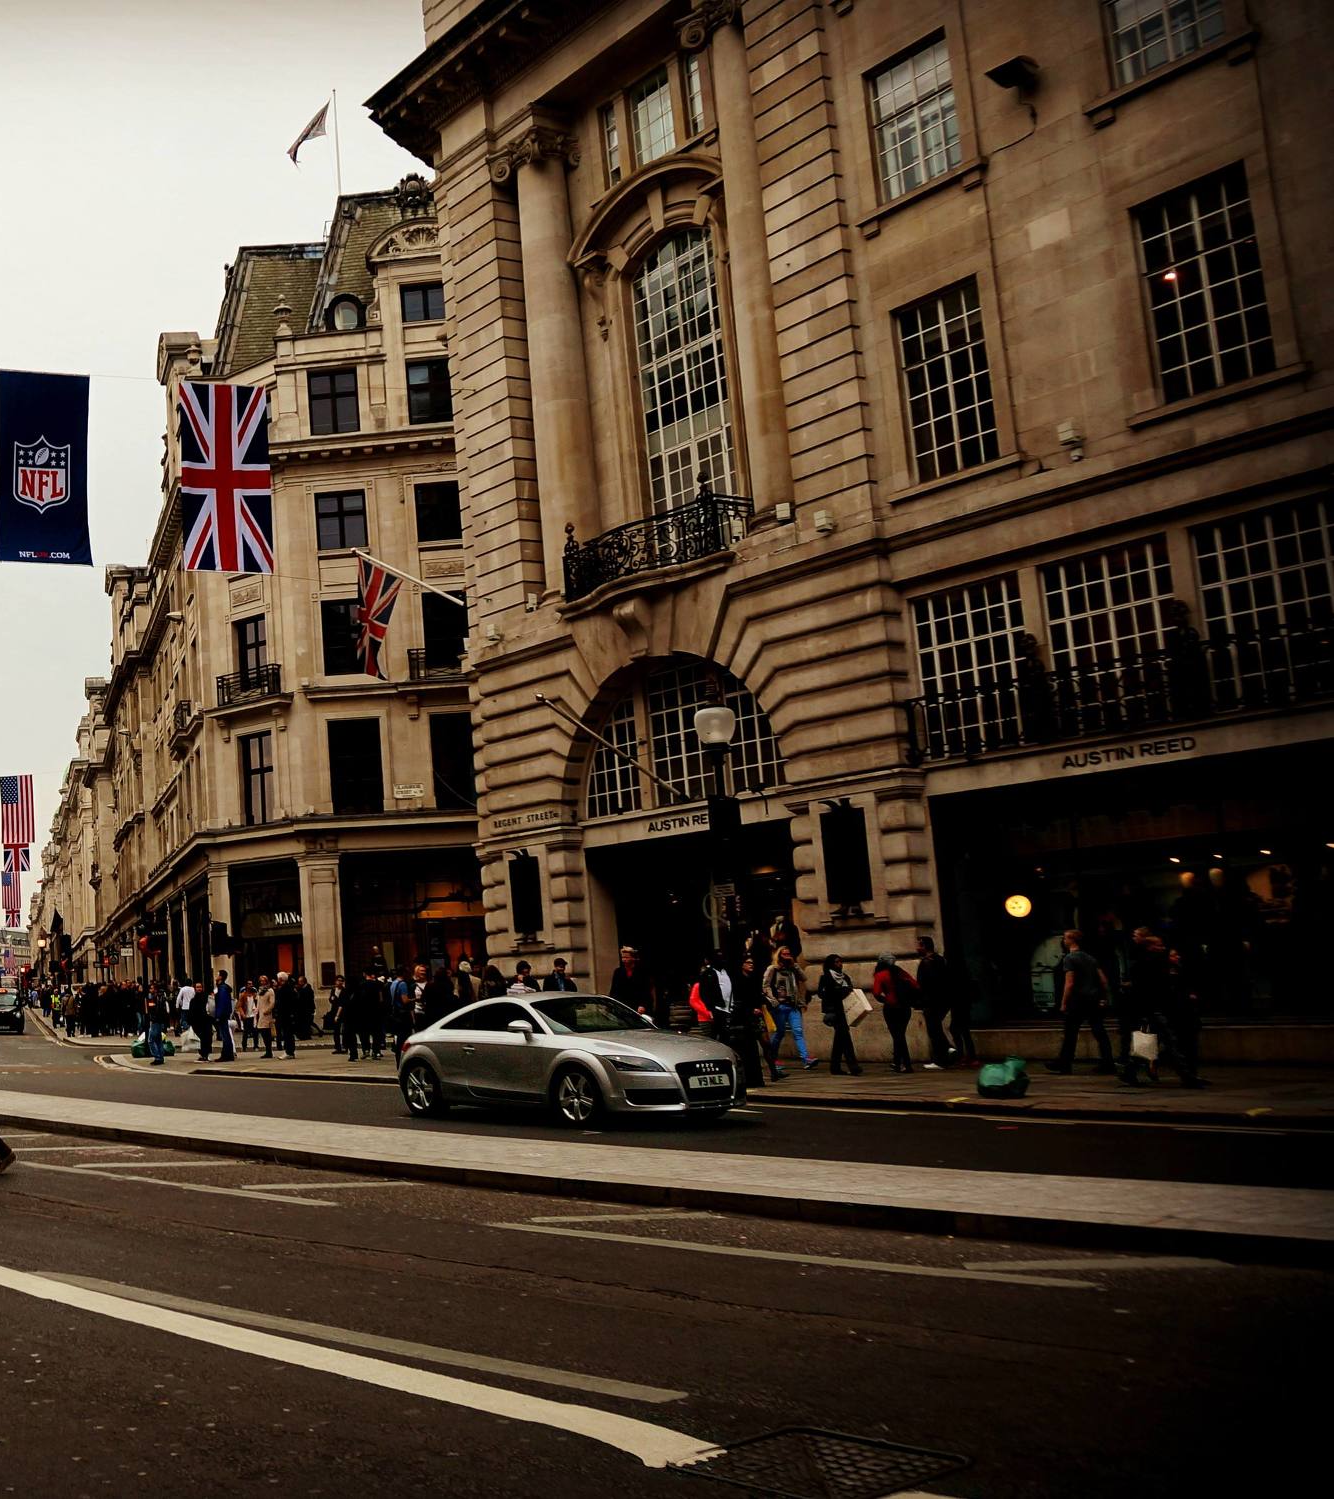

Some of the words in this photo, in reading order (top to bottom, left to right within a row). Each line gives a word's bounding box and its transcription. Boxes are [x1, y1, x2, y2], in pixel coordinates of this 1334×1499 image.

[20, 469, 64, 502] NFL
[1062, 745, 1134, 769] AUSTIN
[1139, 736, 1196, 757] REED
[493, 816, 522, 829] REGENT
[526, 810, 554, 823] STREET
[648, 816, 690, 832] AUSTIN
[692, 813, 708, 824] RE
